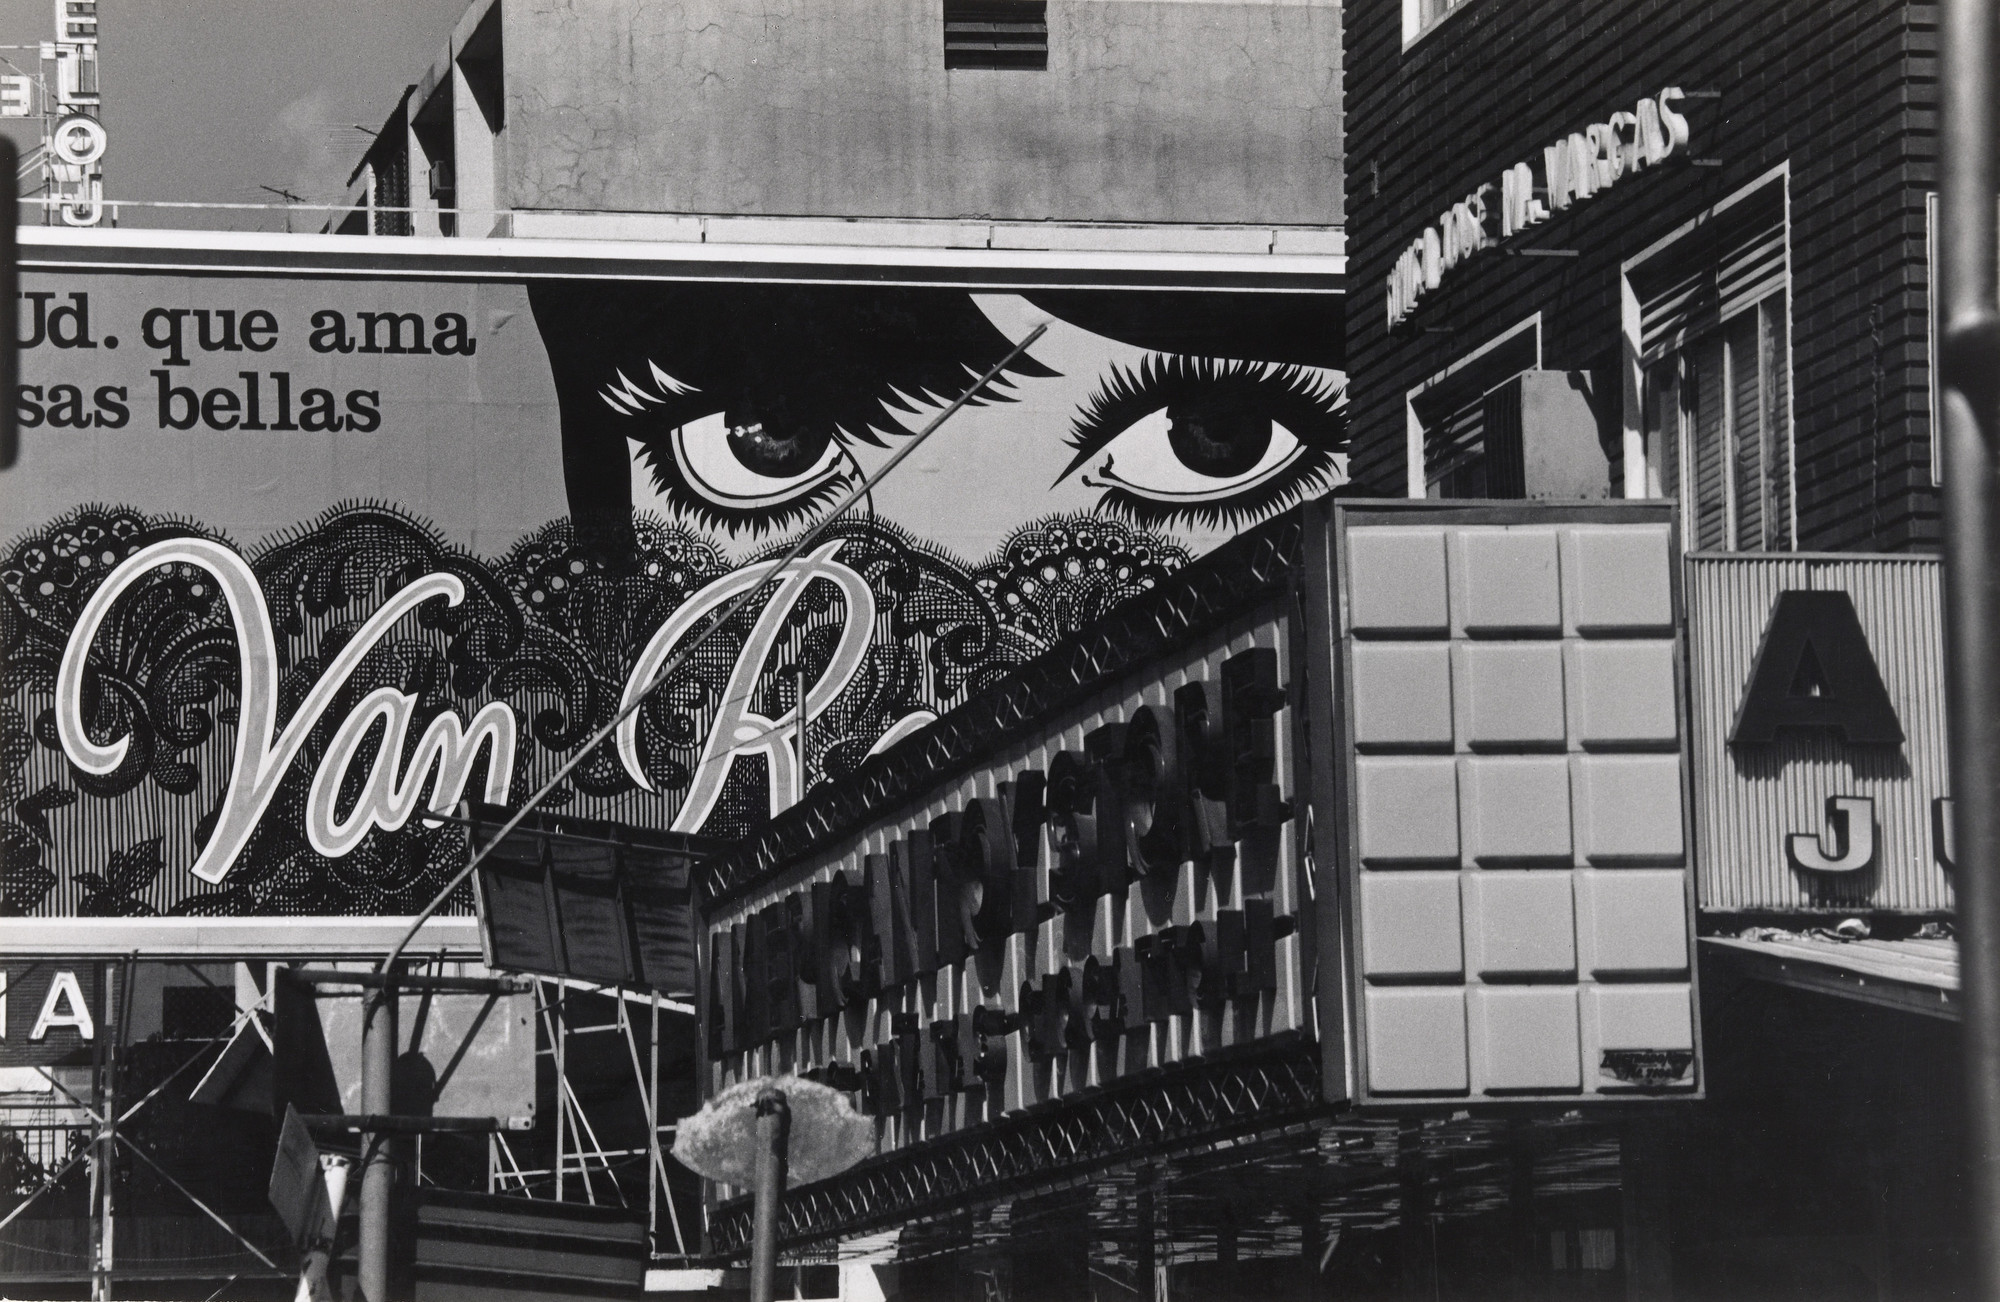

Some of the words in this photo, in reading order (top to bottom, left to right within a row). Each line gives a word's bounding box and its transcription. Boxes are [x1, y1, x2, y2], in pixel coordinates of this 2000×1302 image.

[15, 291, 119, 349] Ud.
[141, 307, 278, 366] que
[309, 308, 477, 356] ama
[150, 369, 381, 432] bellas
[55, 536, 518, 885] Van
[617, 538, 938, 834] R
[0, 970, 95, 1041] A
